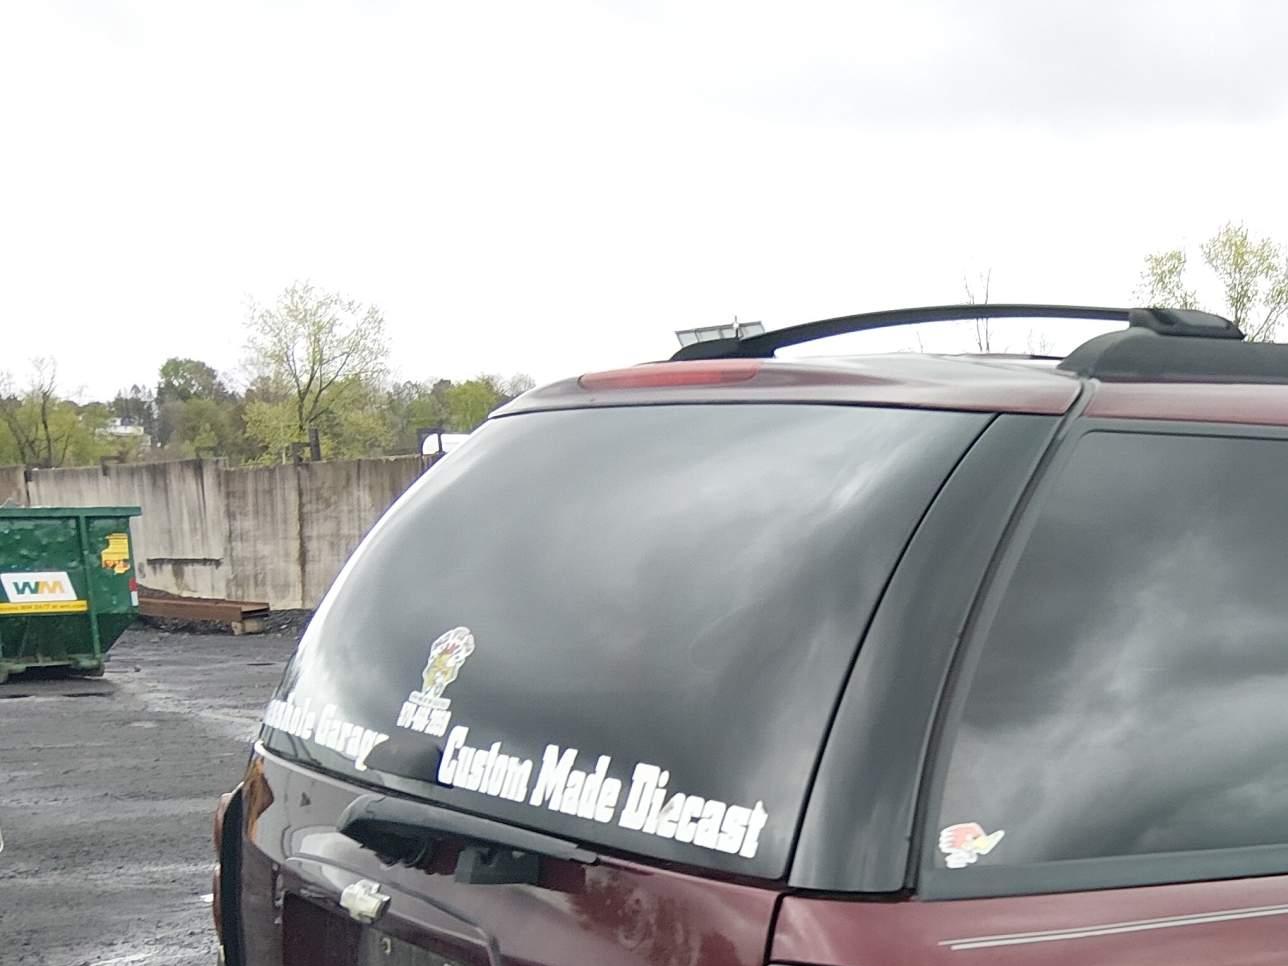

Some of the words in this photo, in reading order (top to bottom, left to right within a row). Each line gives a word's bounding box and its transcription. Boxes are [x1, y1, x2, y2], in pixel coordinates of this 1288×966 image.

[12, 581, 65, 595] WM
[438, 726, 533, 803] Custom
[529, 744, 622, 823] Made
[619, 762, 769, 858] Diecast
